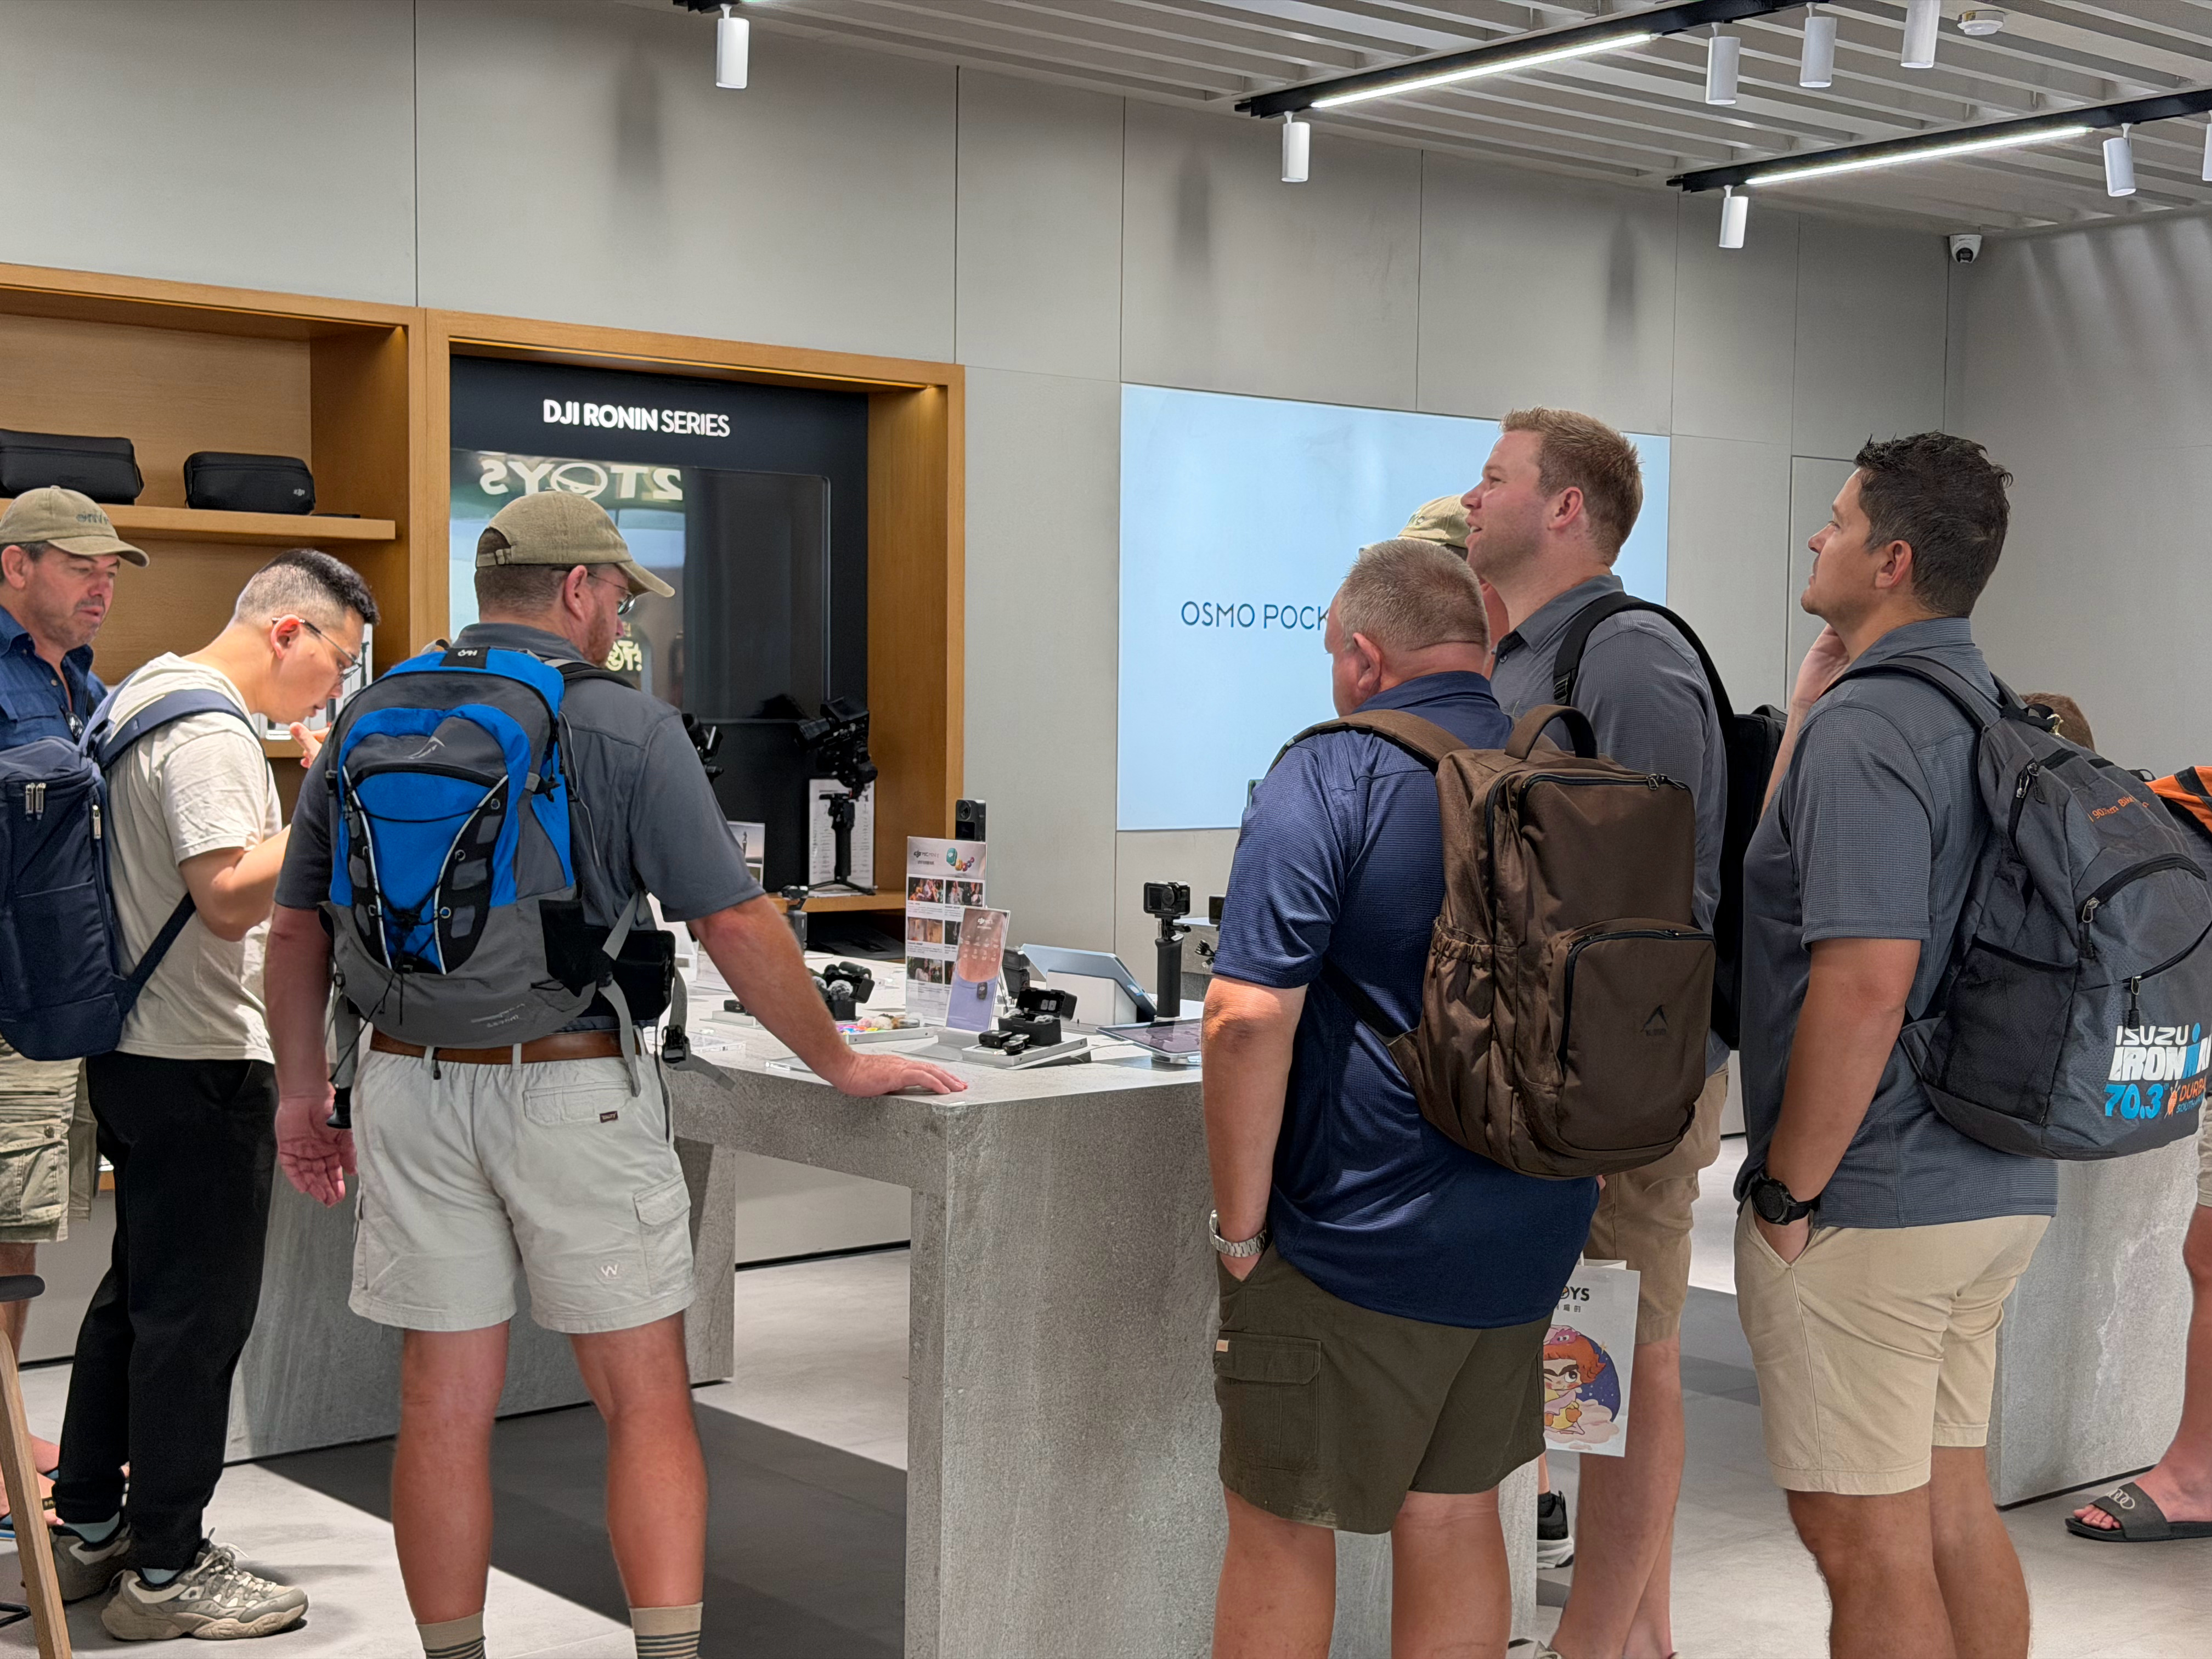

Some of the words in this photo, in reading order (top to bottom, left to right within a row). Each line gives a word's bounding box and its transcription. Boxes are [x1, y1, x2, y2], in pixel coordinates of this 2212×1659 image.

[543, 399, 580, 425] DJI
[583, 403, 658, 432] RONIN
[661, 409, 731, 437] SERIES
[1181, 601, 1255, 628] OSMO
[2115, 1024, 2189, 1046] ISUZU
[2103, 1083, 2164, 1120] 70.3
